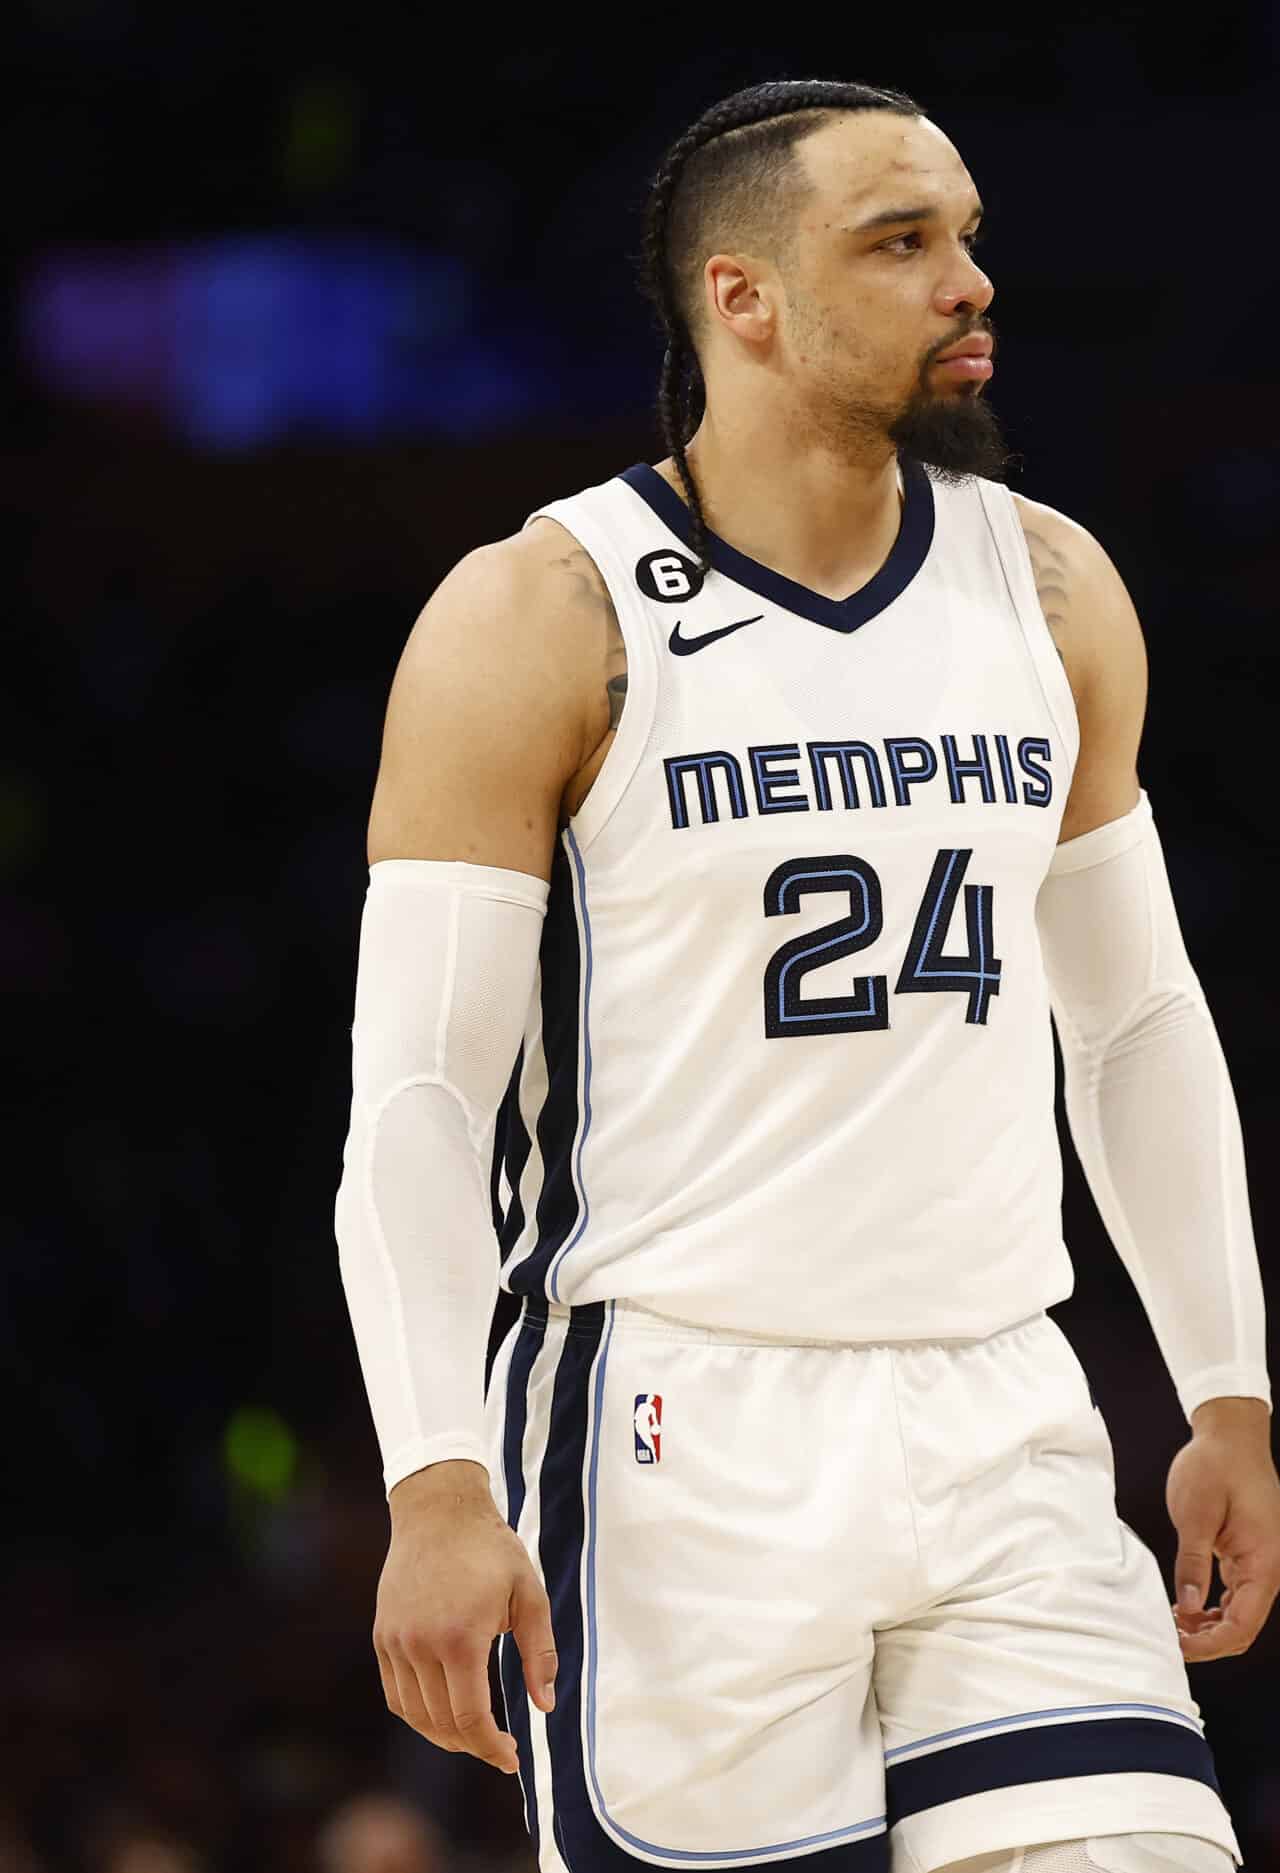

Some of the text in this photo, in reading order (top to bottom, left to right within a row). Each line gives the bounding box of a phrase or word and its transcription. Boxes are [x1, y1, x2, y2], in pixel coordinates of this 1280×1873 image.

[649, 556, 691, 597] 6
[663, 735, 1053, 829] MEMPHIS
[763, 848, 1002, 1039] 24
